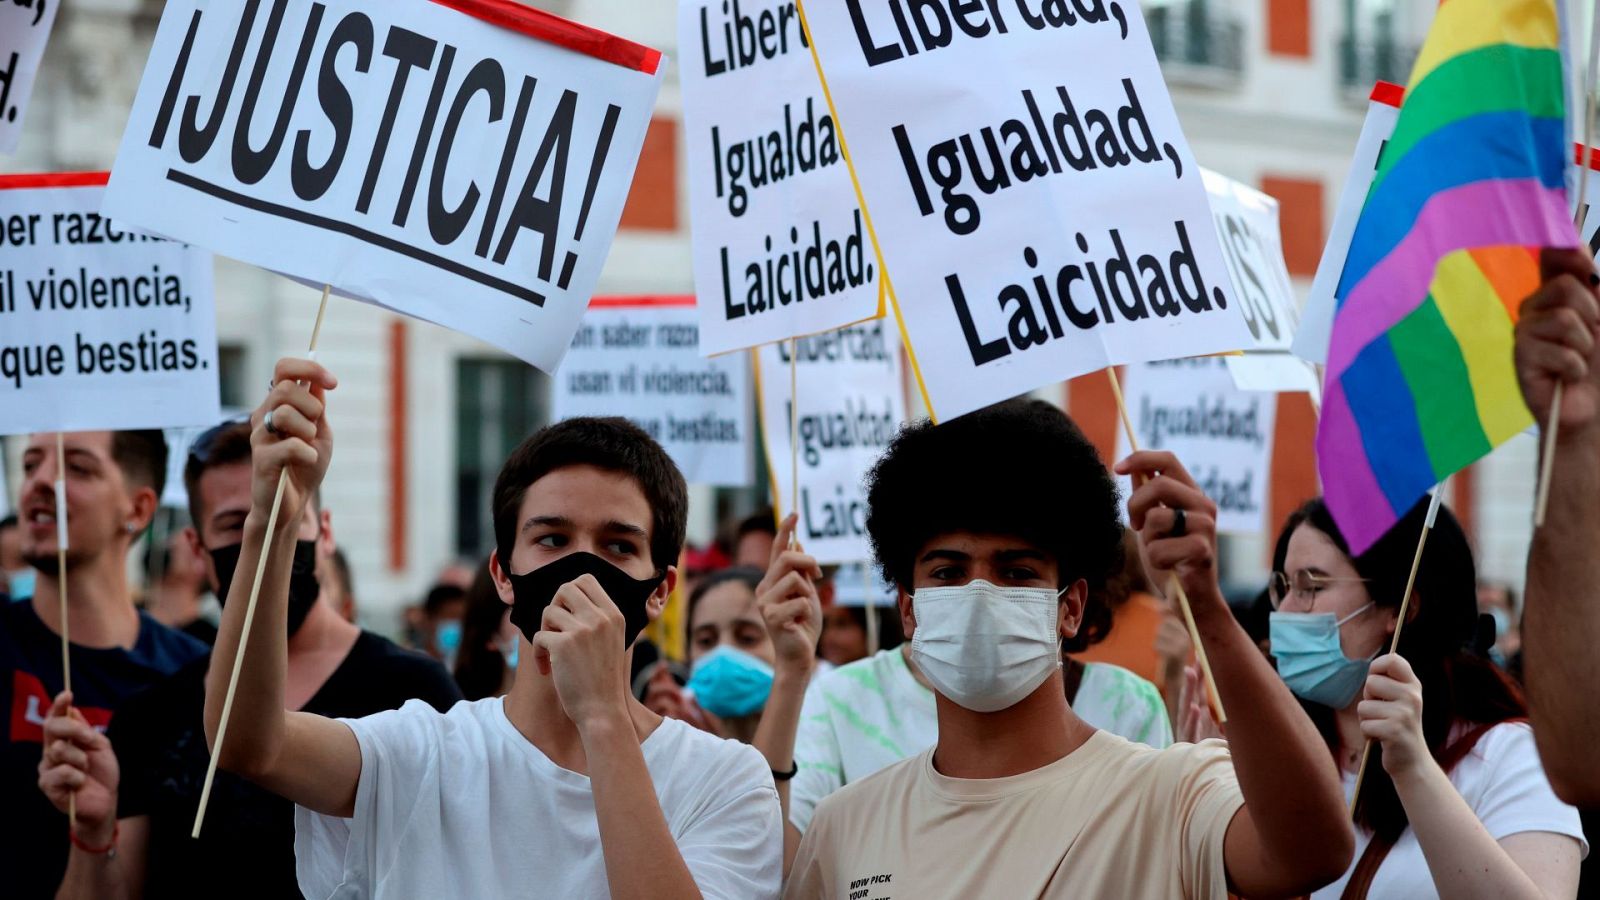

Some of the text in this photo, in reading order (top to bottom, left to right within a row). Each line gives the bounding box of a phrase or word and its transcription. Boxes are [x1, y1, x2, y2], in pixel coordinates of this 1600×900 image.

[711, 97, 847, 217] Igualda
[891, 78, 1182, 235] Igualdad,
[27, 264, 191, 314] violencia,
[721, 208, 873, 320] Laicidad.
[945, 220, 1227, 366] Laicidad.
[1, 330, 209, 389] que bestias.
[850, 873, 892, 890] NOW PICK
